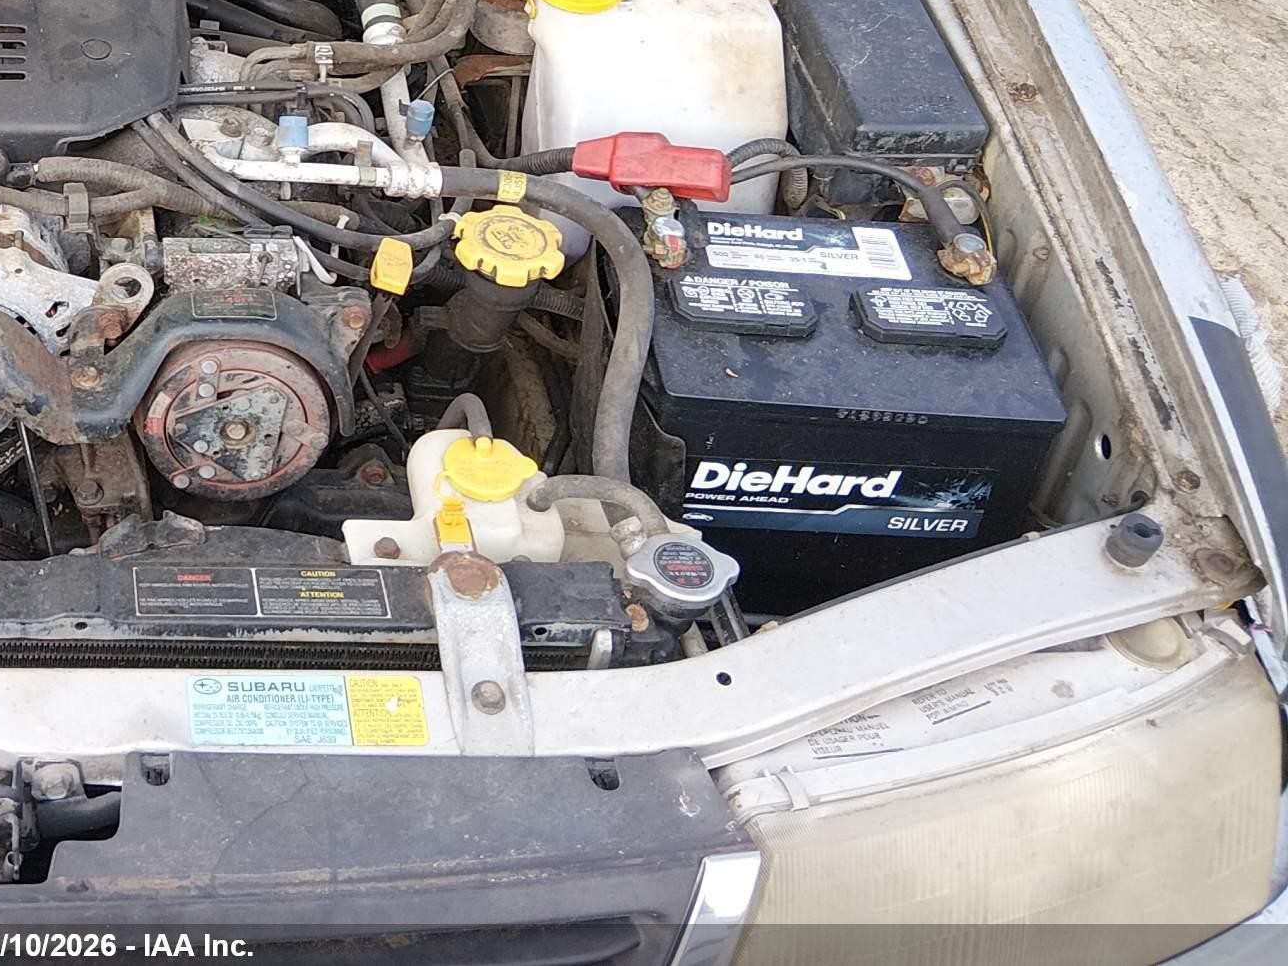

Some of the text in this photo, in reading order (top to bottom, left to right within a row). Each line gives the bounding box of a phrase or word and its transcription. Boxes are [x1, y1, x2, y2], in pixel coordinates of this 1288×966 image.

[707, 221, 804, 241] DieHard
[820, 251, 859, 261] SILVER
[694, 276, 739, 286] DANGER
[749, 279, 790, 289] POISON
[690, 461, 904, 498] DieHard
[685, 492, 791, 504] POWER AHEAD
[887, 516, 969, 533] SILVER
[228, 681, 305, 692] SUBARU
[227, 695, 240, 703] AIR
[242, 695, 295, 703] CONDITIONER
